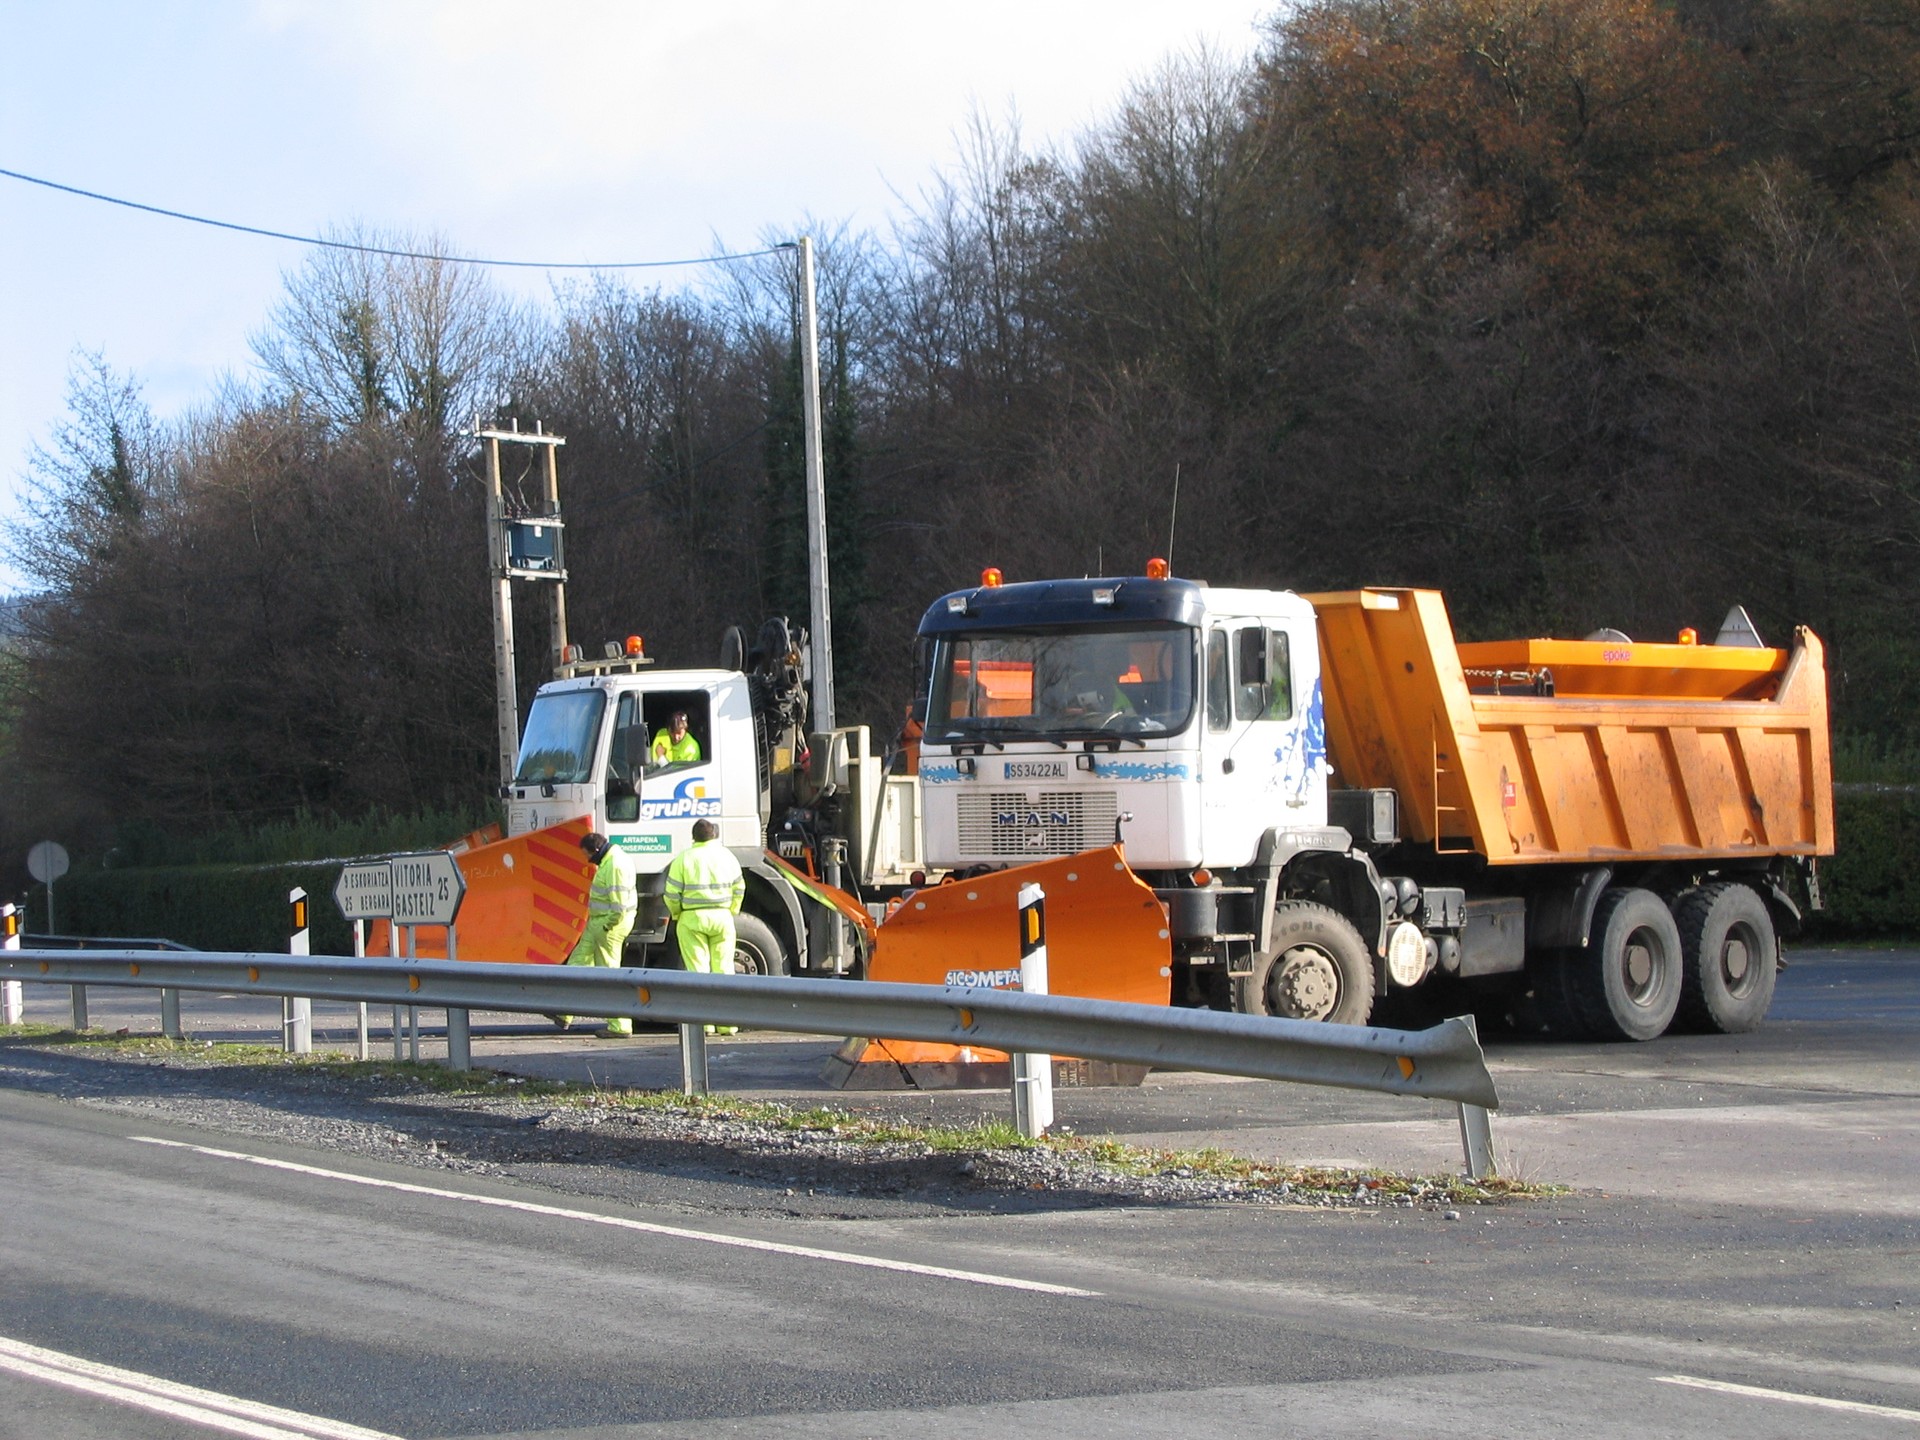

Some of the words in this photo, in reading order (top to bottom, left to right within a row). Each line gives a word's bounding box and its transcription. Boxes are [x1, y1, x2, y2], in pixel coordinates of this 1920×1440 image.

[1603, 647, 1631, 663] epoke
[998, 811, 1070, 826] MAN
[619, 843, 667, 852] ONSERVACIÓN
[622, 836, 659, 844] ARTAPENA
[344, 874, 350, 889] 9
[350, 871, 389, 889] ESKORIATZA
[394, 863, 433, 888] VITORIA
[437, 877, 449, 901] 25
[345, 896, 353, 912] 25
[360, 893, 390, 911] BERGARA
[395, 892, 435, 917] GASTEIZ
[945, 970, 1023, 988] SICOMETA
